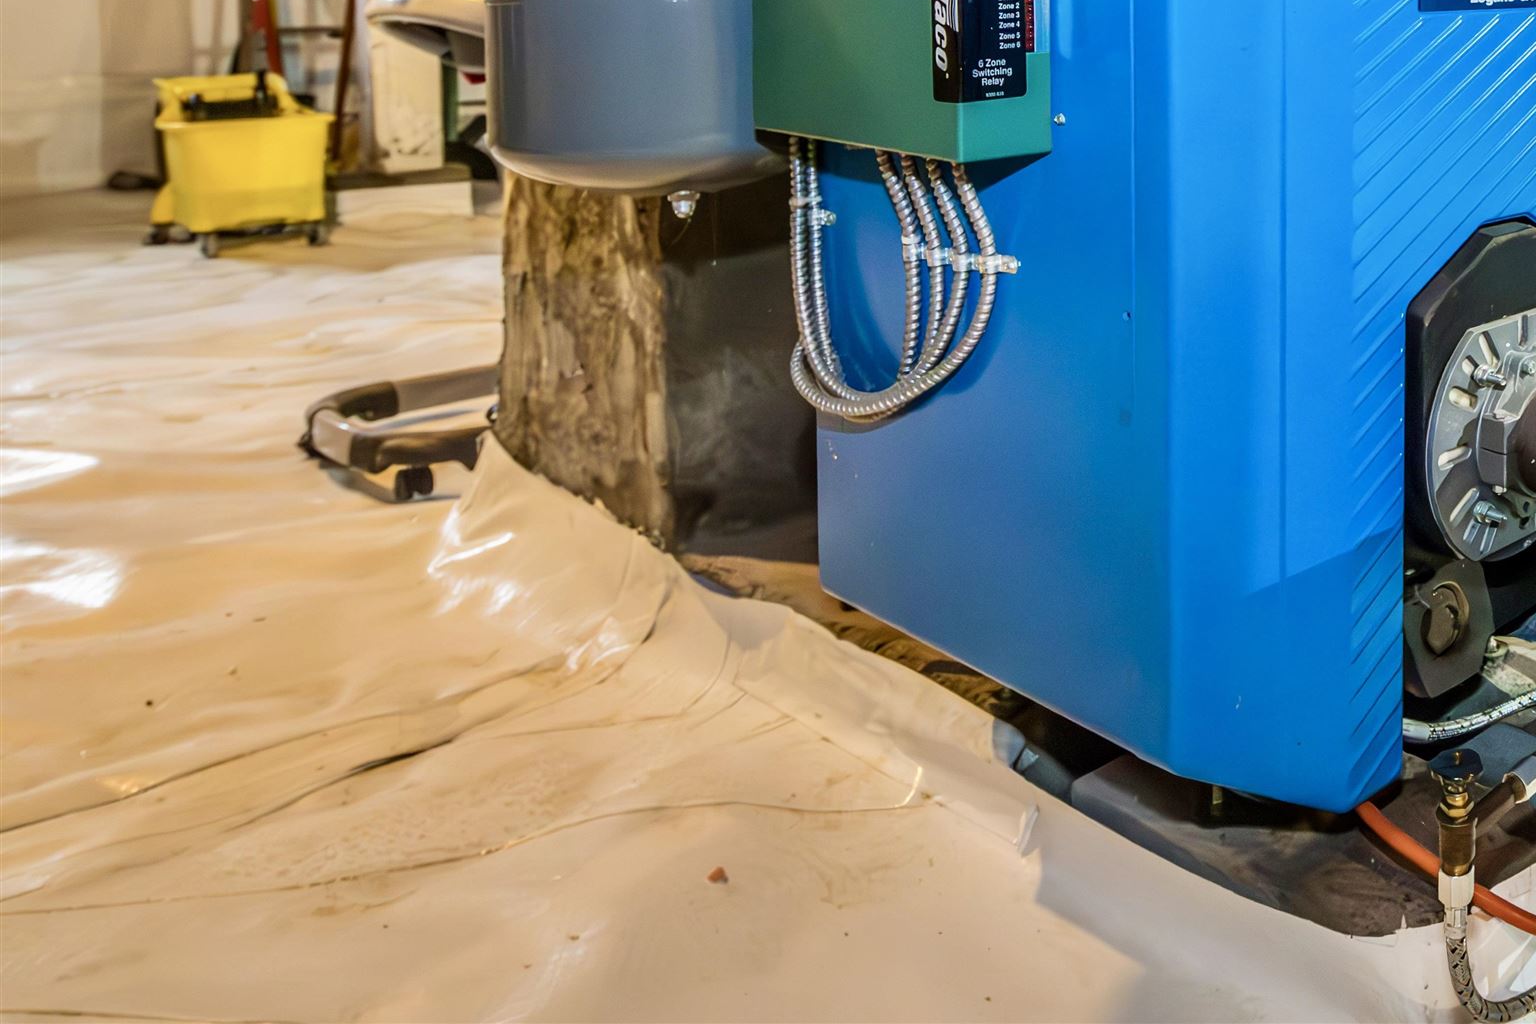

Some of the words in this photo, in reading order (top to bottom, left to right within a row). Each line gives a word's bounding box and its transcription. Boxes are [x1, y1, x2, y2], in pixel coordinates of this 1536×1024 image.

[998, 21, 1015, 29] Zone
[978, 59, 984, 68] 6
[985, 58, 1007, 67] Zone
[972, 67, 1013, 78] Switching
[981, 77, 1005, 86] Relay
